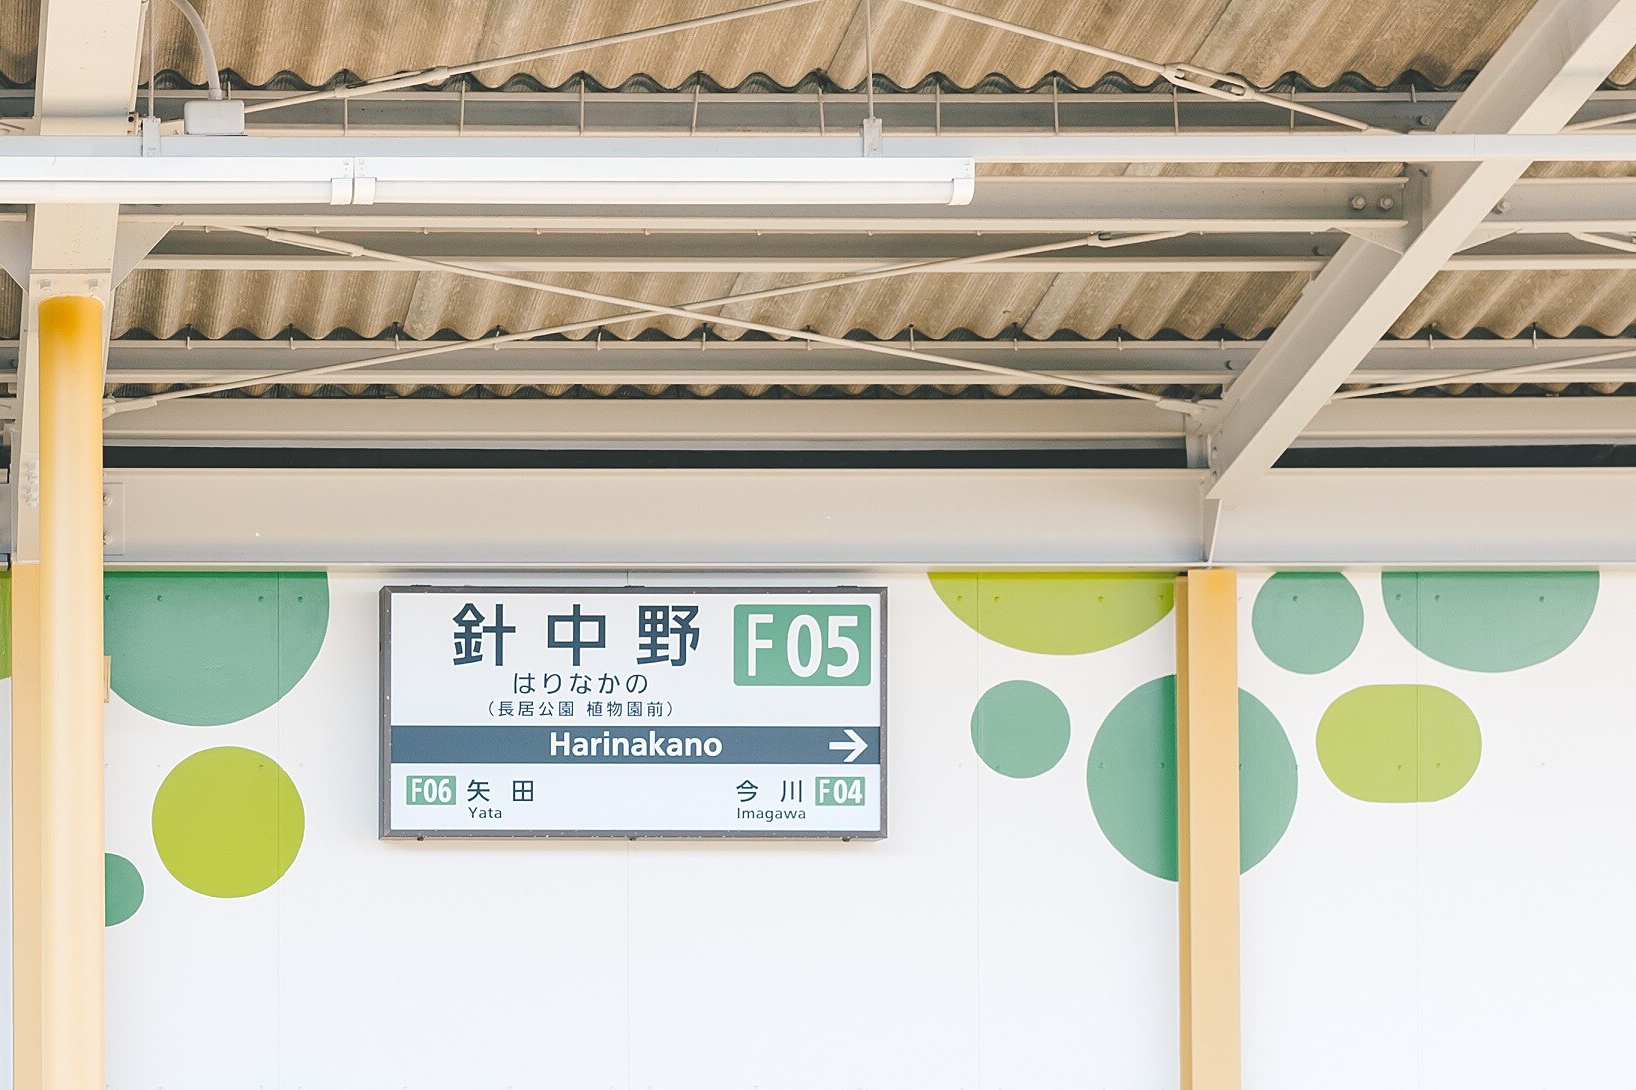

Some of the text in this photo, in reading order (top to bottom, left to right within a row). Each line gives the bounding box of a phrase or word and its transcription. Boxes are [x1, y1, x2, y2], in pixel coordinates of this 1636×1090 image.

[452, 602, 700, 667] 針中野
[747, 613, 860, 678] F05
[513, 672, 649, 695] はりなかの
[550, 730, 723, 757] Harinakano
[411, 778, 453, 803] F06
[466, 779, 534, 802] 矢田
[735, 779, 802, 803] 今川
[818, 778, 863, 804] F04
[467, 806, 502, 819] Yata
[737, 807, 806, 823] Imagawa
